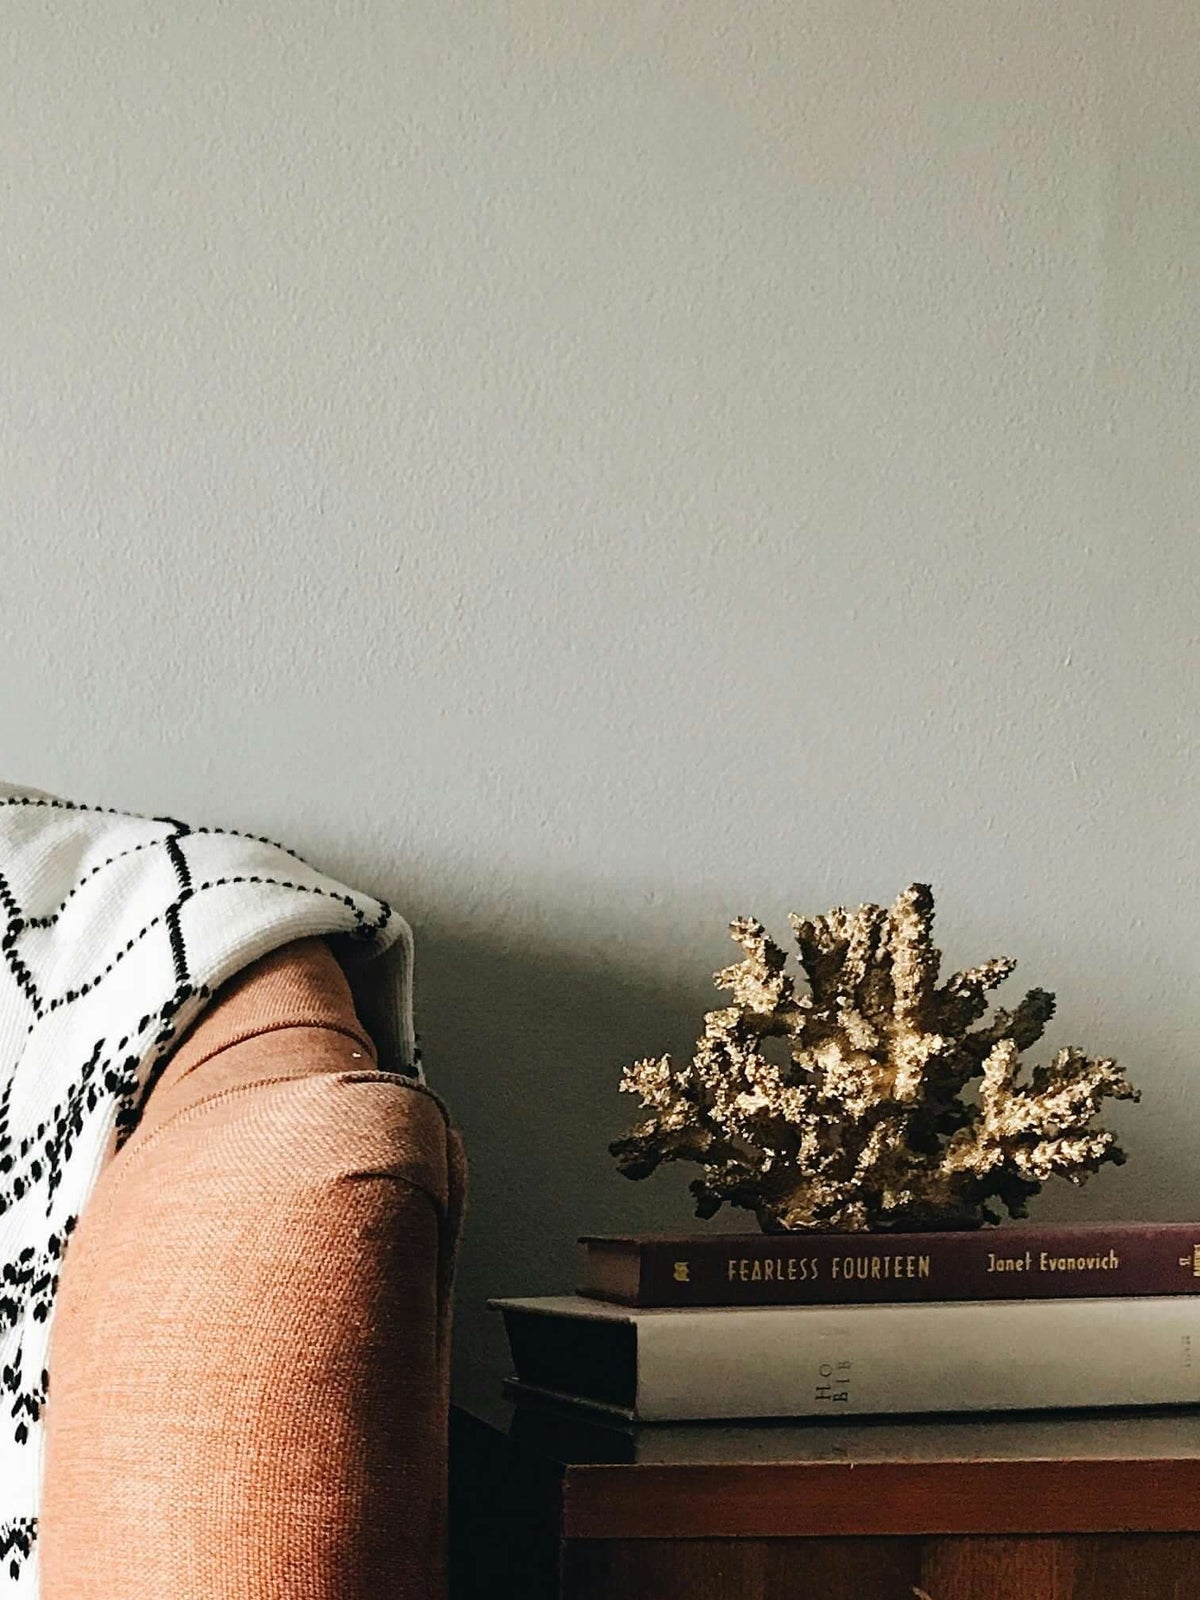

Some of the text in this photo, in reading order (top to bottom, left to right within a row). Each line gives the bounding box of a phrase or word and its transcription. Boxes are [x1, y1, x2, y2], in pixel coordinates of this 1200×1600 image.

[728, 1255, 931, 1281] FEARLESS FOURTEEN
[987, 1249, 1119, 1273] Janet Evanovich
